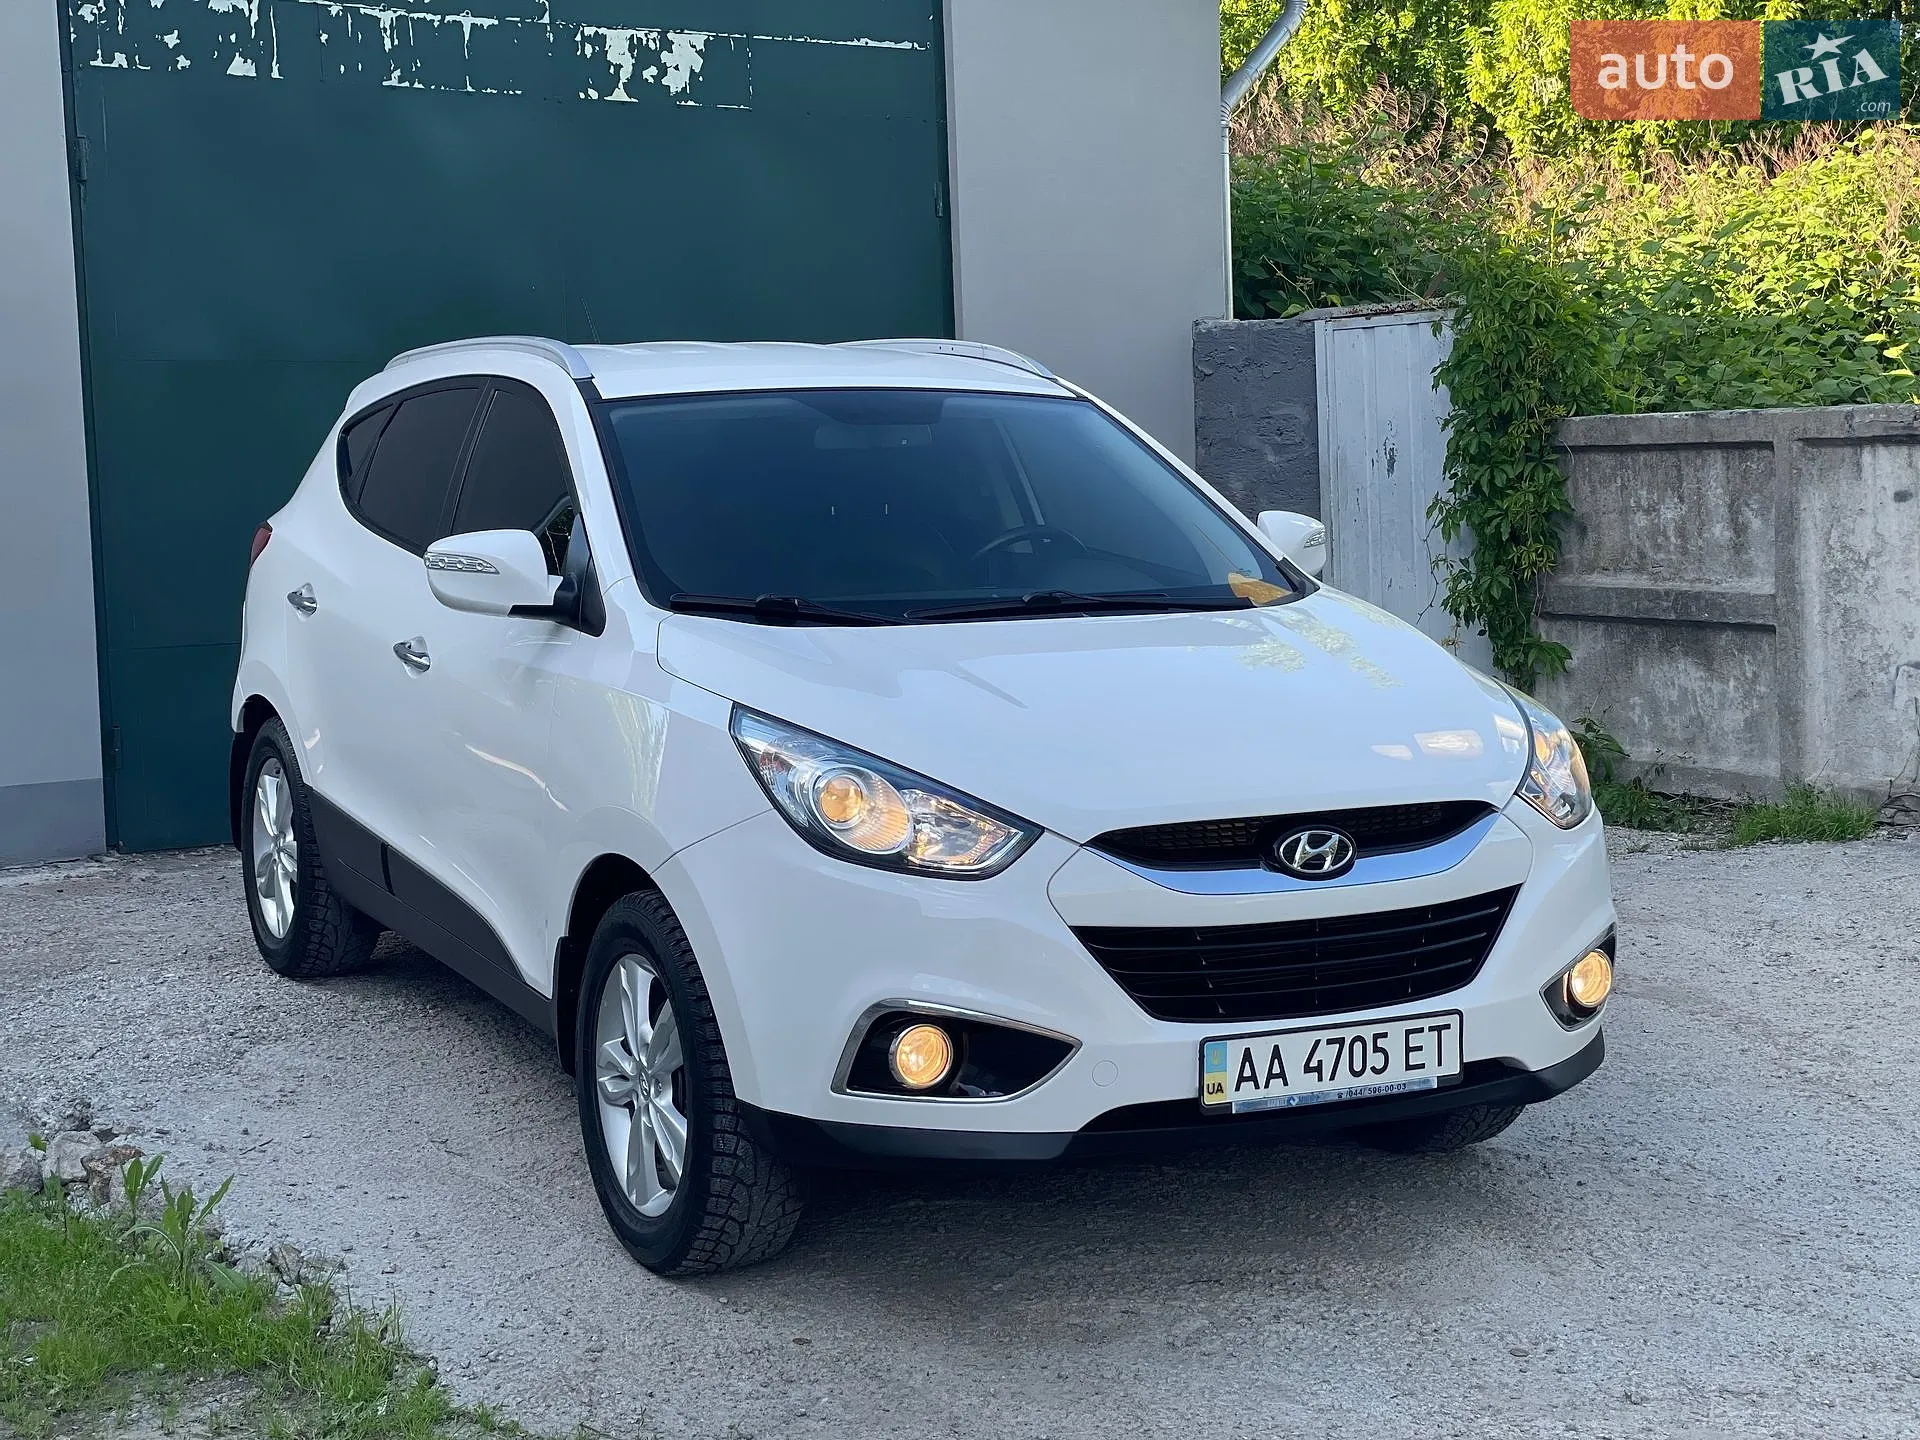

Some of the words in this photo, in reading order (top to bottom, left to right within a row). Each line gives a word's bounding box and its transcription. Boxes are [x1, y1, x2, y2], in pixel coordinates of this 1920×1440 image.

[1234, 1044, 1289, 1092] AA
[1303, 1032, 1390, 1083] 4705
[1404, 1023, 1452, 1072] ET
[1207, 1082, 1225, 1095] UA
